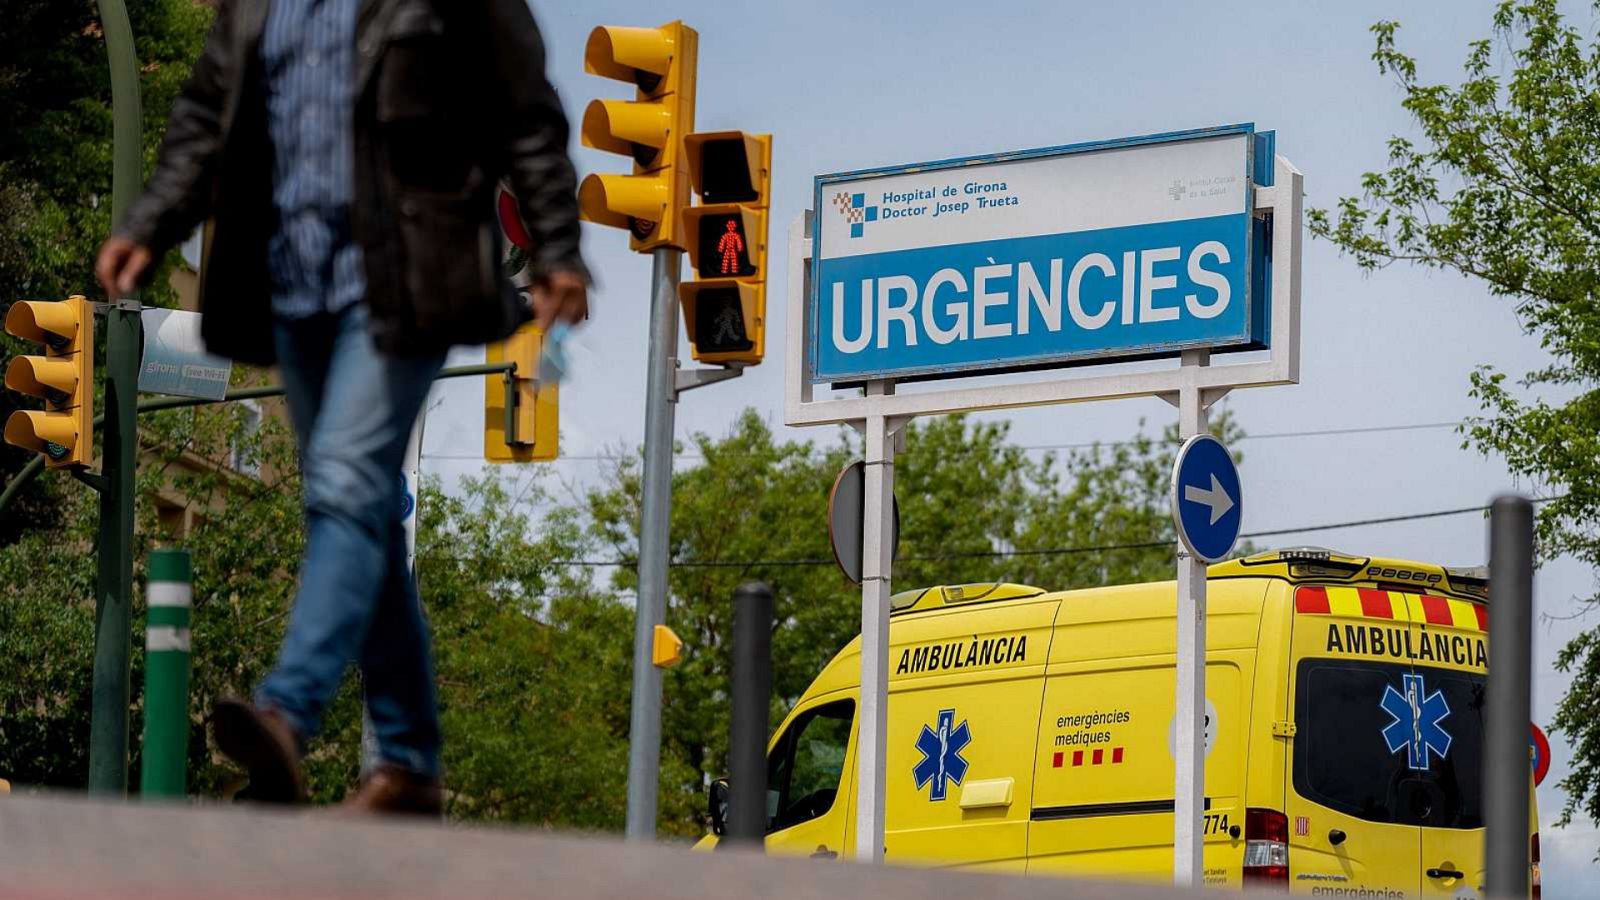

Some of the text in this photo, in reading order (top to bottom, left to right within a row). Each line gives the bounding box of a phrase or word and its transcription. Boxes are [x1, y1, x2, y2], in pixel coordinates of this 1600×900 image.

[883, 182, 1007, 205] Hospital de Girona
[882, 196, 1019, 219] Doctor Josep Trueta
[832, 240, 1231, 354] URGÈNCIES
[896, 634, 1027, 675] AMBULÀNCIA
[1327, 623, 1489, 669] AMBULÀNCIA
[1057, 708, 1130, 729] emergències
[1054, 730, 1111, 747] mediques
